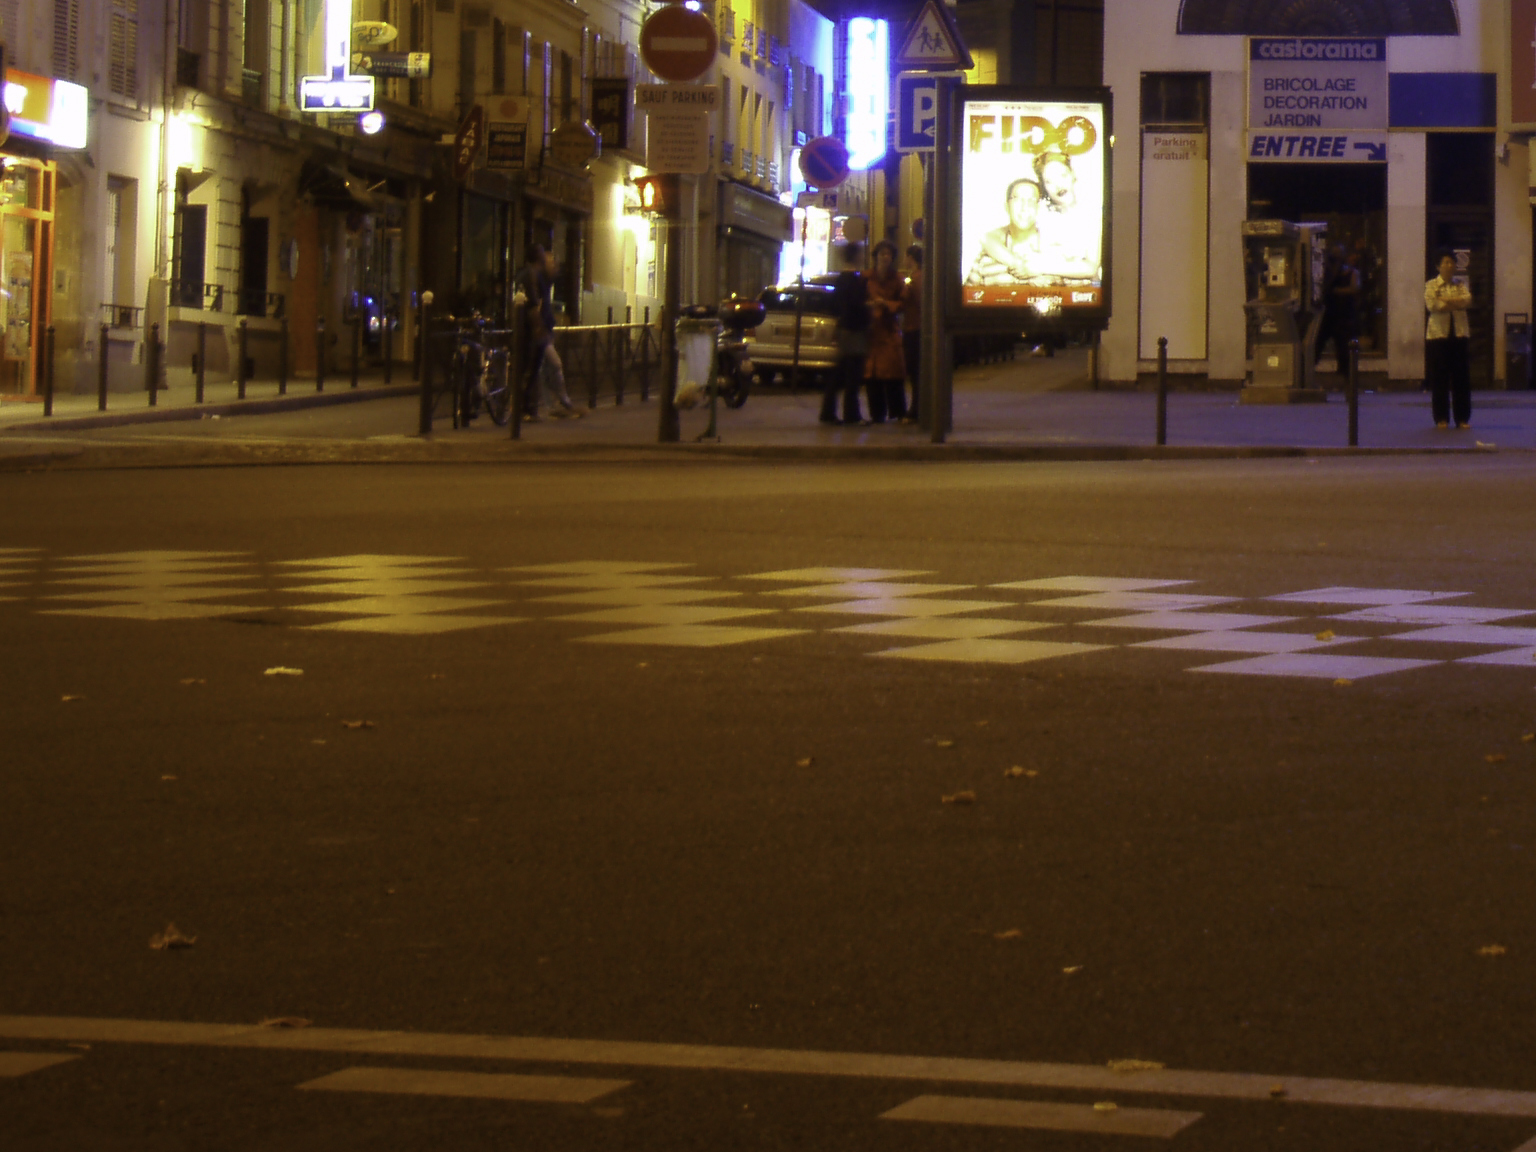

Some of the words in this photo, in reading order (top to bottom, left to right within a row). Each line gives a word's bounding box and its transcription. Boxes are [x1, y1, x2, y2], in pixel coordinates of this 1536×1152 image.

[1258, 38, 1378, 59] castorama
[1263, 78, 1357, 92] BRICOLAGE
[642, 90, 668, 103] SAUF
[672, 90, 715, 105] PARKING
[1263, 96, 1368, 110] DECORATION
[1263, 113, 1322, 127] JARDIN
[1153, 136, 1197, 148] Parking
[1250, 135, 1348, 158] ENTREE
[1152, 151, 1190, 161] gratuit
